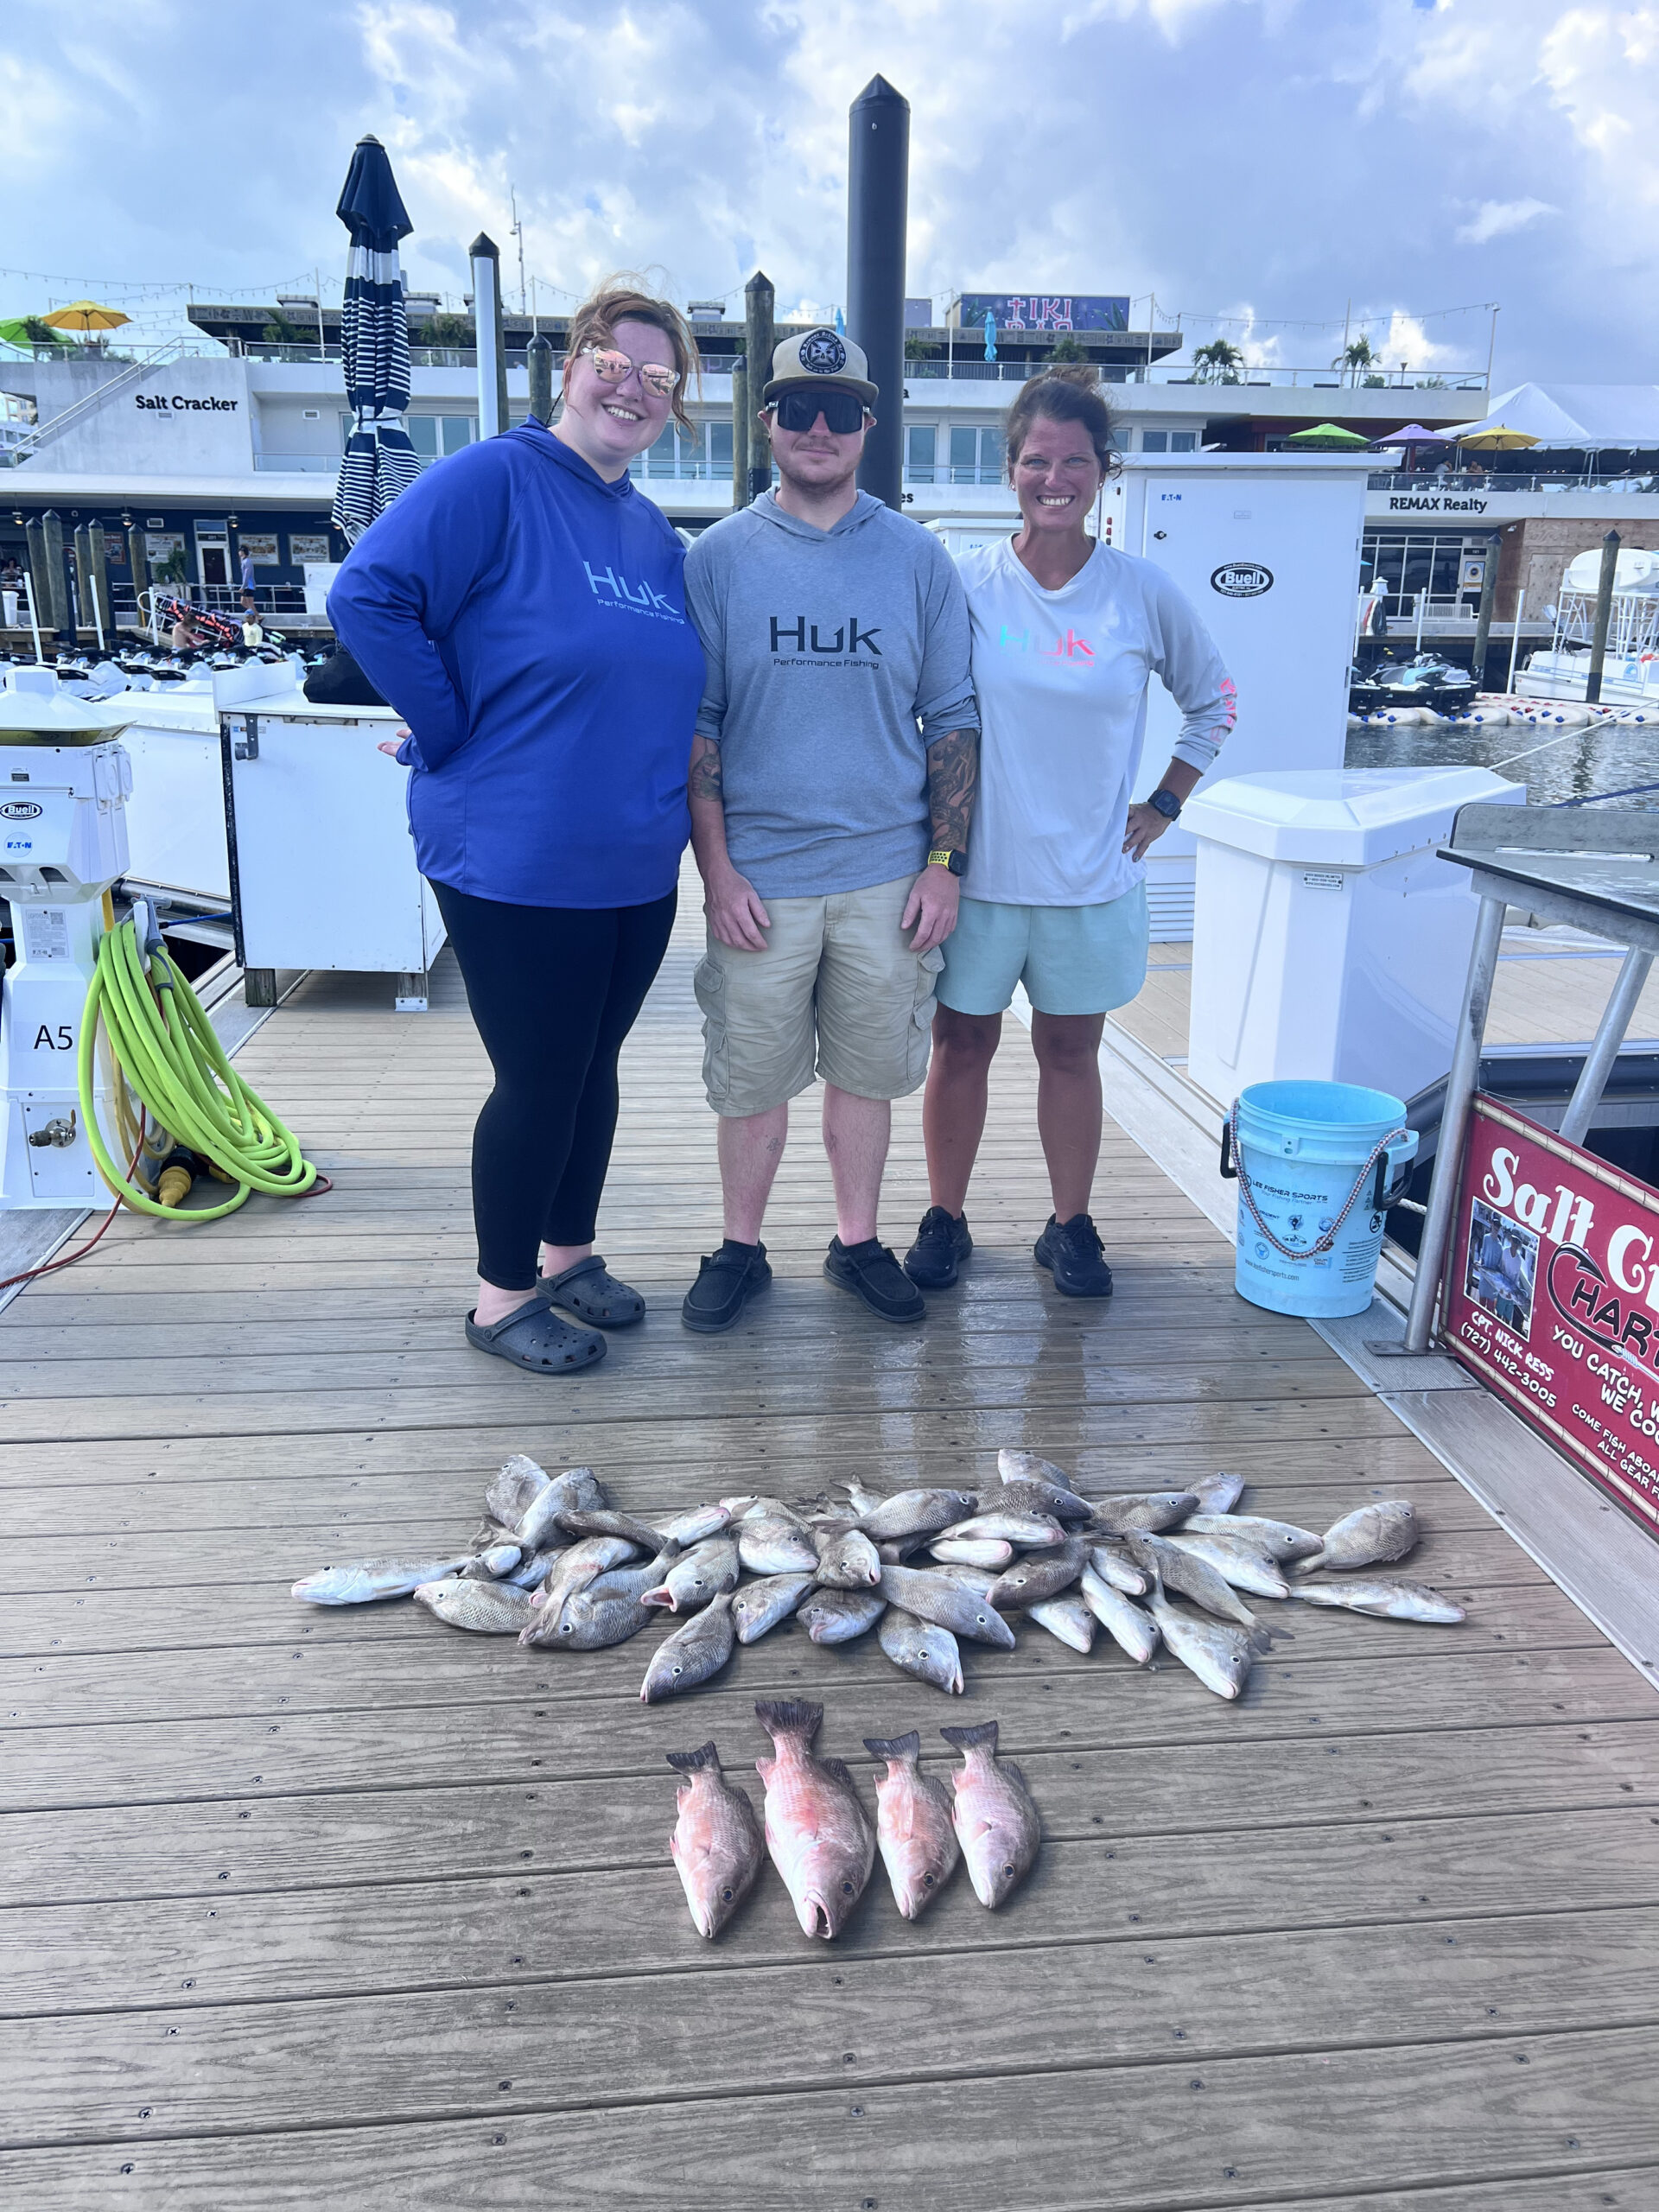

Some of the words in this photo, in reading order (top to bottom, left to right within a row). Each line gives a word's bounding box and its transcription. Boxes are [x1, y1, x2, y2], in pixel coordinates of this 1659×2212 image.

[1007, 297, 1072, 321] TIKI
[136, 395, 168, 410] Salt
[172, 396, 238, 410] Cracker
[1389, 497, 1440, 510] REMAX
[1443, 498, 1487, 513] Realty
[1225, 571, 1260, 584] Buell
[597, 599, 655, 617] Performance
[655, 611, 685, 624] Fishing
[774, 658, 842, 667] Performance
[844, 659, 879, 670] Fishing
[34, 1025, 73, 1050] A5
[1253, 1179, 1263, 1189] LEE
[1264, 1185, 1290, 1197] FISHER
[1292, 1192, 1328, 1201] SPORTS
[1483, 1147, 1595, 1254] Salt
[1471, 1311, 1494, 1336] CPT.
[1495, 1328, 1523, 1359] NICK
[1524, 1351, 1554, 1382] RESS
[1460, 1322, 1491, 1354] (727)
[1493, 1349, 1557, 1408] 442-3005
[1552, 1325, 1584, 1358] YOU
[1586, 1353, 1643, 1409] CATCH,
[1600, 1382, 1626, 1414] WE
[1572, 1404, 1602, 1433] COME
[1602, 1428, 1626, 1453] FISH
[1598, 1441, 1618, 1460] ALL
[1619, 1459, 1650, 1489] GEAR
